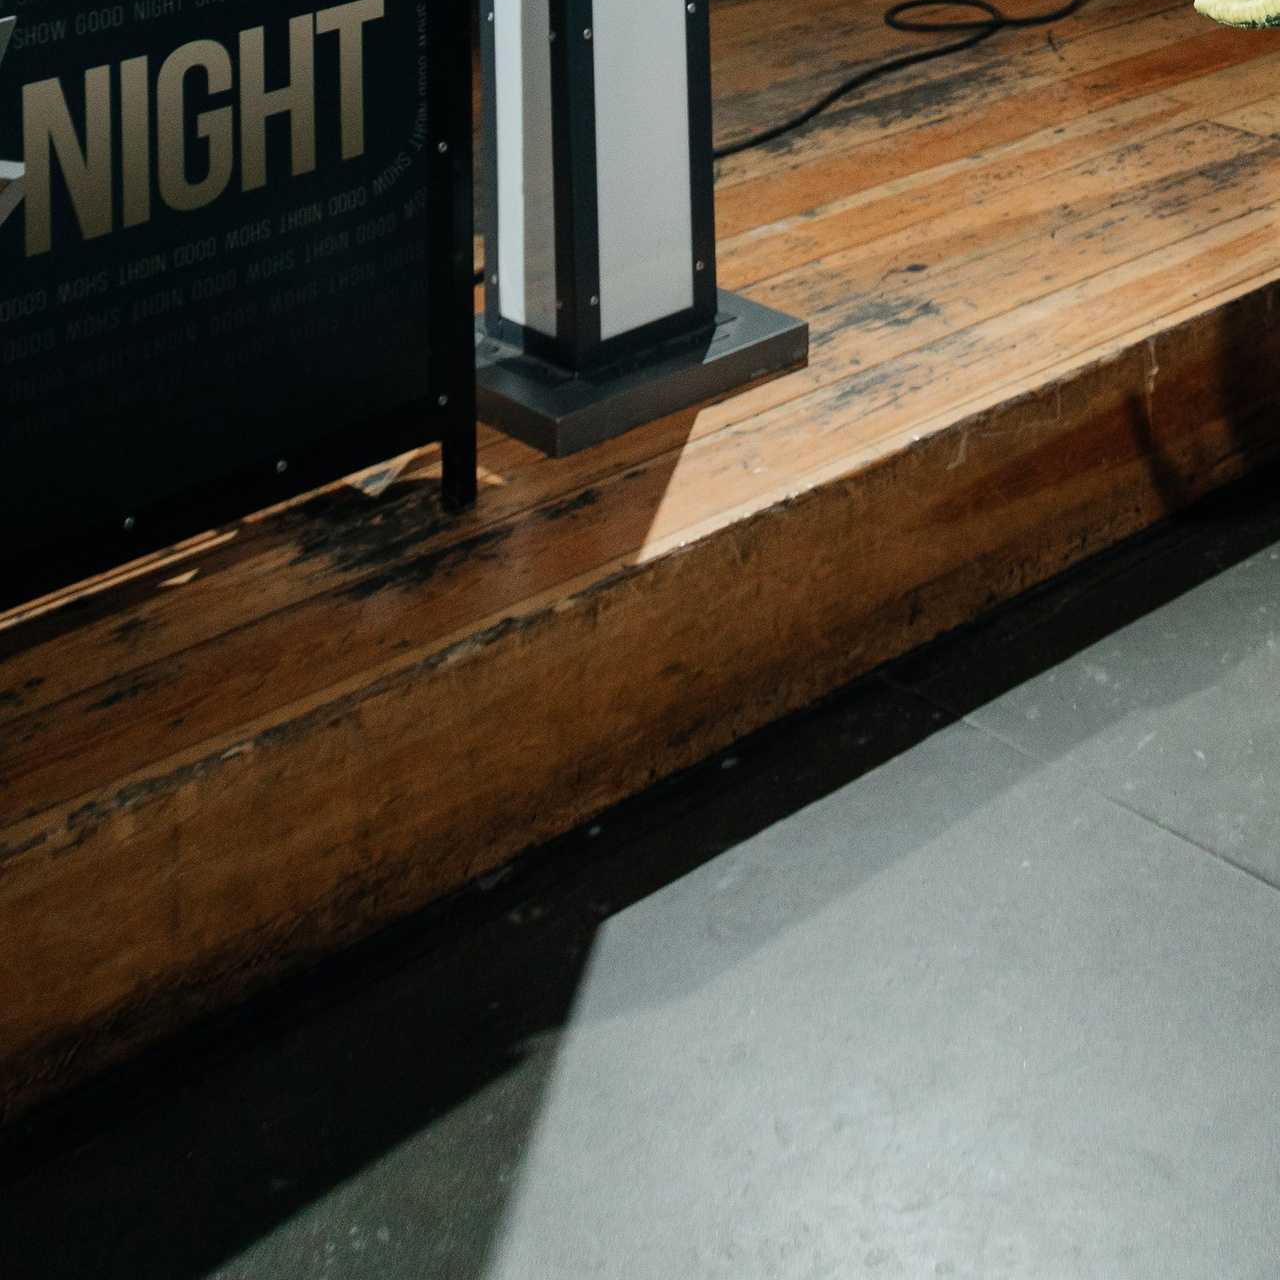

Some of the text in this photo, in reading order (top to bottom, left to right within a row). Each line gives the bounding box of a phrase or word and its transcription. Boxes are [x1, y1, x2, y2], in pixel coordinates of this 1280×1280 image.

[13, 18, 67, 50] SHOW
[75, 5, 124, 36] GOOD
[0, 150, 412, 323] SHOW GOOD NIGHT SHOW GOOD NIGHT SHOW GOOD
